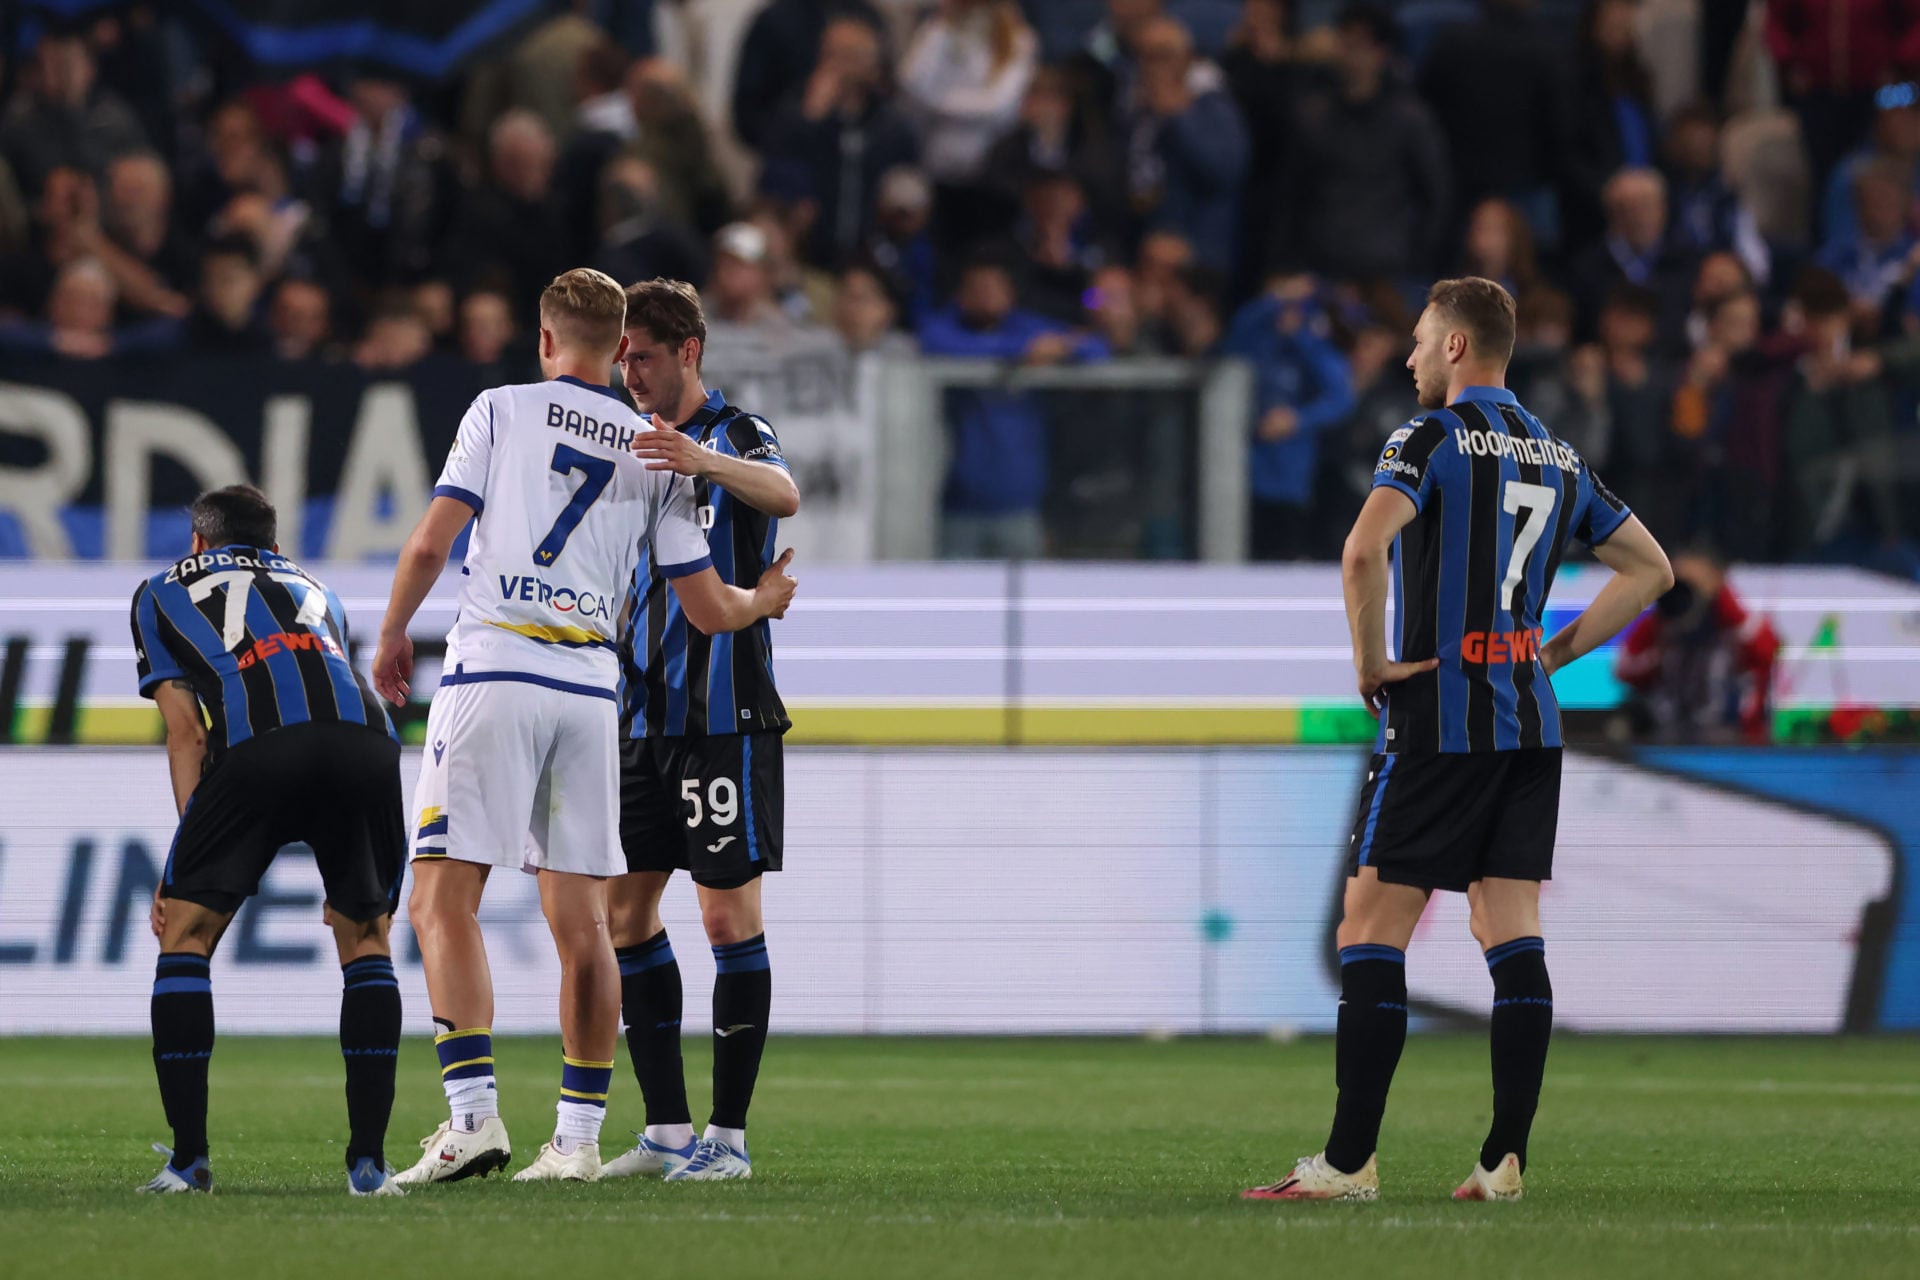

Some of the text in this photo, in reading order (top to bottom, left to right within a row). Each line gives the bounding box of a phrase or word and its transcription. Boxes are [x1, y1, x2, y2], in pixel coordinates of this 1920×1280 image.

[531, 443, 616, 567] 7
[1501, 480, 1556, 611] 7
[187, 570, 328, 652] 77
[499, 574, 615, 621] VETROCA
[681, 777, 738, 828] 59
